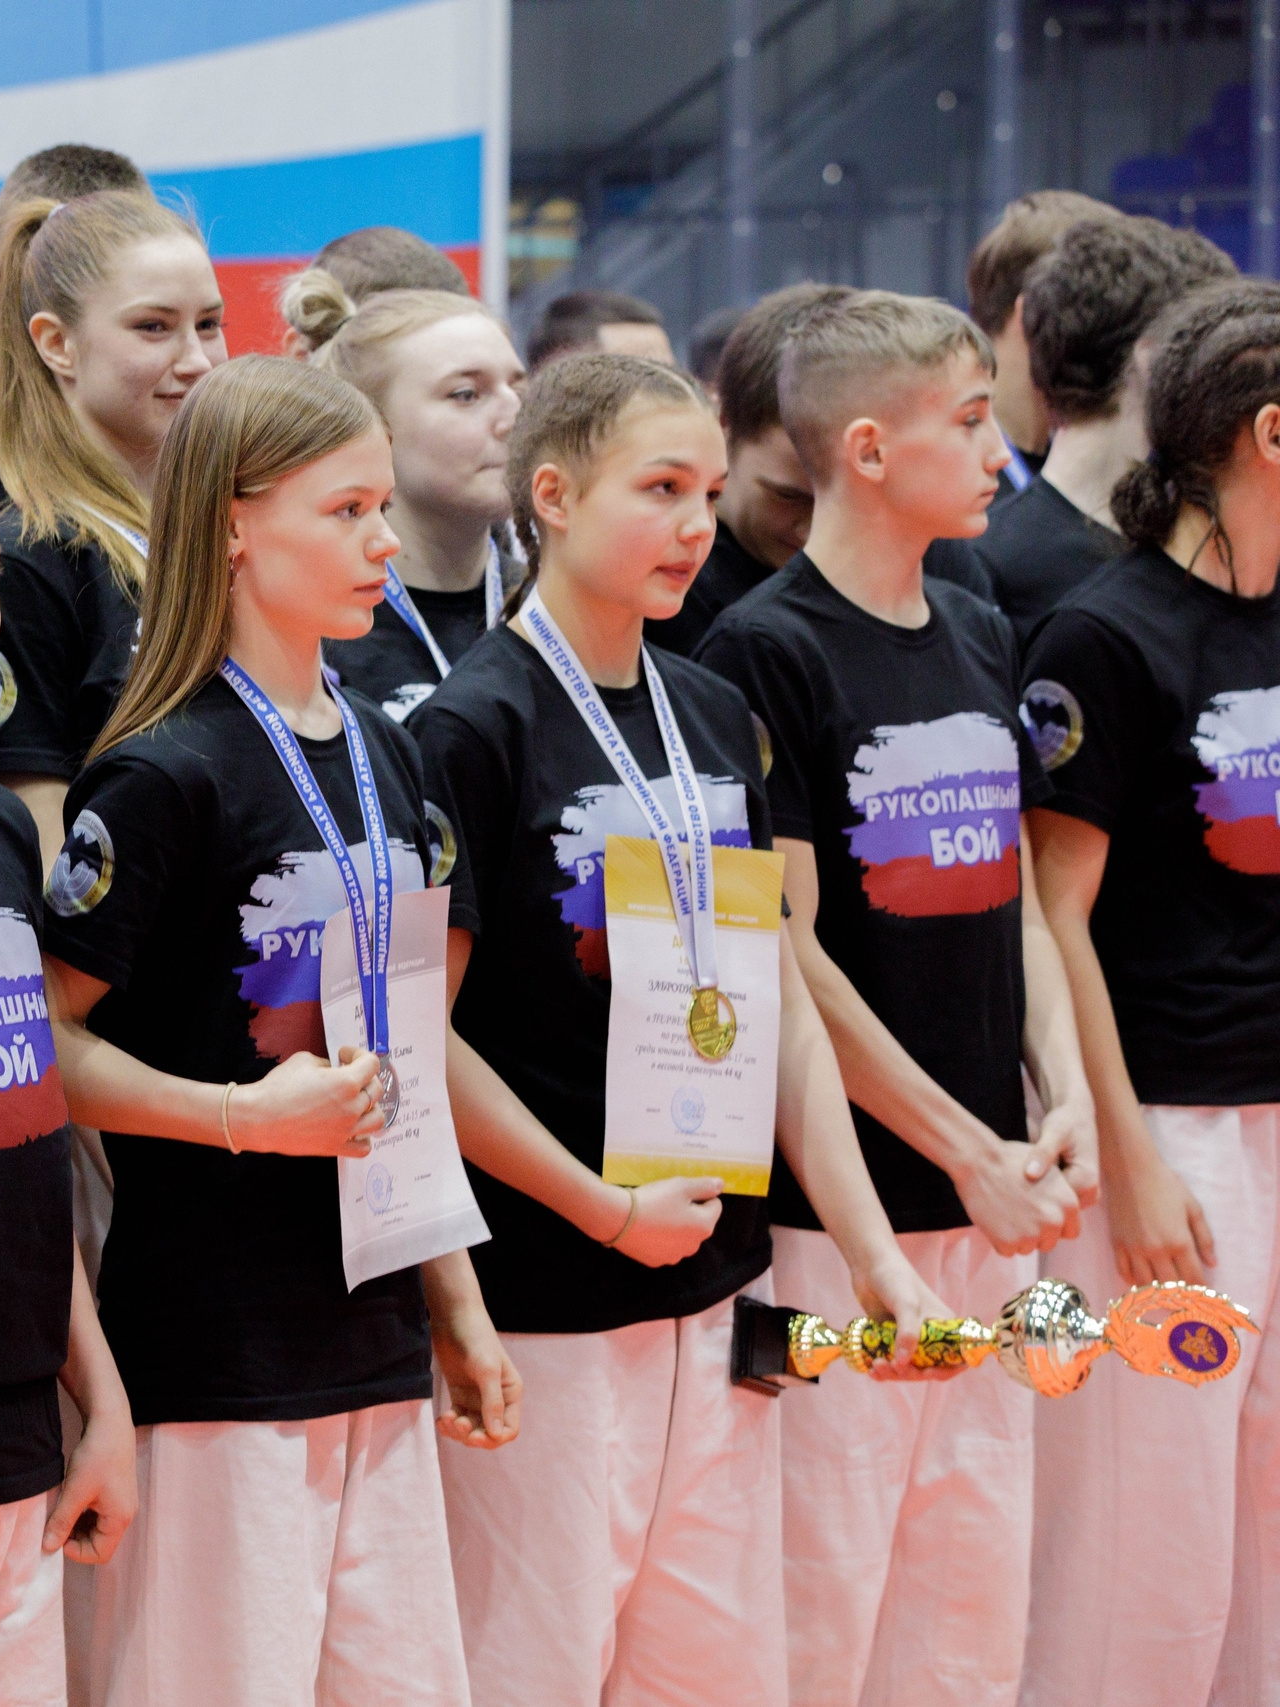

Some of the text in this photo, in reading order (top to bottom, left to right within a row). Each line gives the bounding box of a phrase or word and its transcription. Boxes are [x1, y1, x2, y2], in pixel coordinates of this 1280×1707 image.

[527, 607, 691, 916] МИНИСТЕРСТВО СПОРТА РОССИЙСКОЙ ФЕДЕРАЦИИ
[674, 756, 696, 802] СПОРТА
[865, 782, 1019, 822] РУКОПАШНЫЙ
[688, 804, 707, 911] МИНИСТЕРСТВО
[930, 818, 1001, 867] БОЙ
